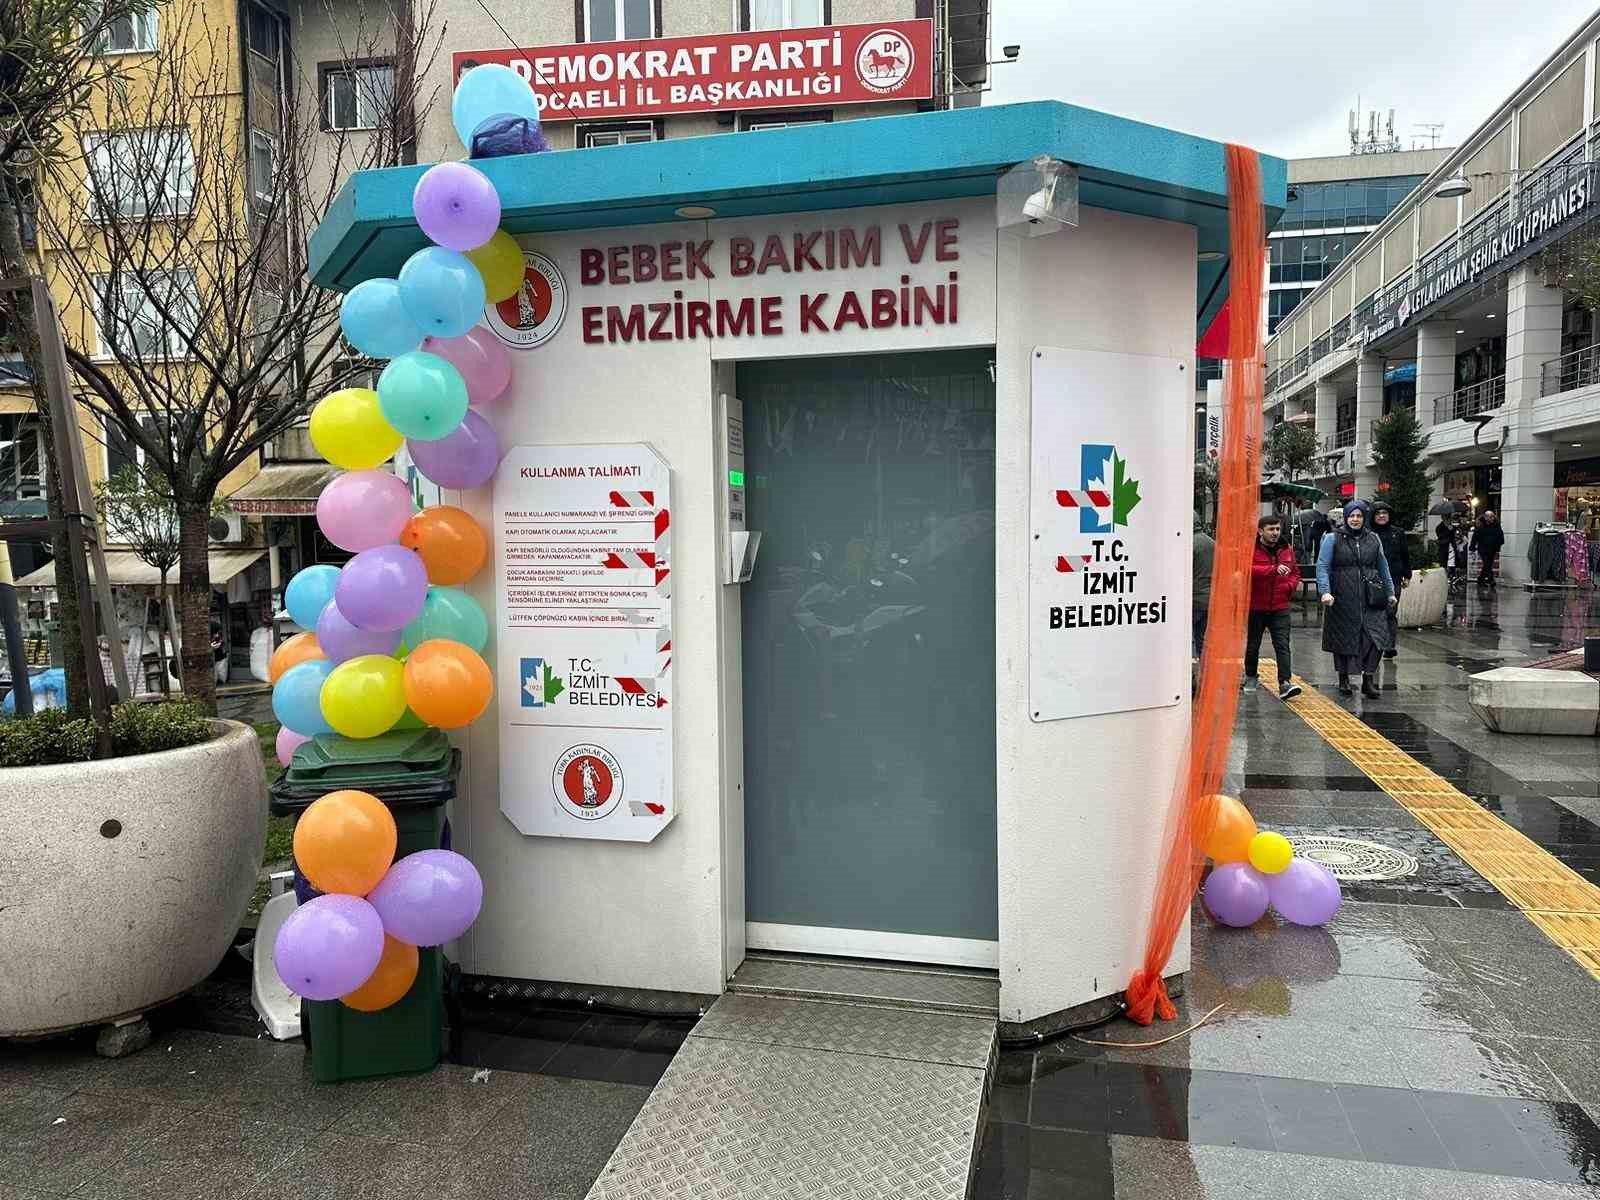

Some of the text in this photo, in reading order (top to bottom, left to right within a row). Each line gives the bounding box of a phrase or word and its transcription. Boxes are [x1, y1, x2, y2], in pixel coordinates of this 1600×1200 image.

[510, 31, 843, 86] DEMOKRAT PARTİ
[883, 40, 901, 53] DP
[535, 71, 841, 111] OCAELİ İL BAŞKANLIĞI
[580, 218, 960, 286] BEBEK BAKIM VE
[1411, 167, 1591, 314] LEYLA ATAKAN ŞEHİR KÜTÜPHANESİ
[581, 271, 958, 345] EMZİRME KABİNİ
[520, 464, 641, 478] KULLANMA TALİMATI
[1091, 539, 1129, 562] T.C.
[1083, 565, 1137, 595] İZMİT
[1049, 596, 1166, 630] BELEDİYESİ
[567, 658, 596, 673] T.C.
[569, 672, 610, 689] İZMİT
